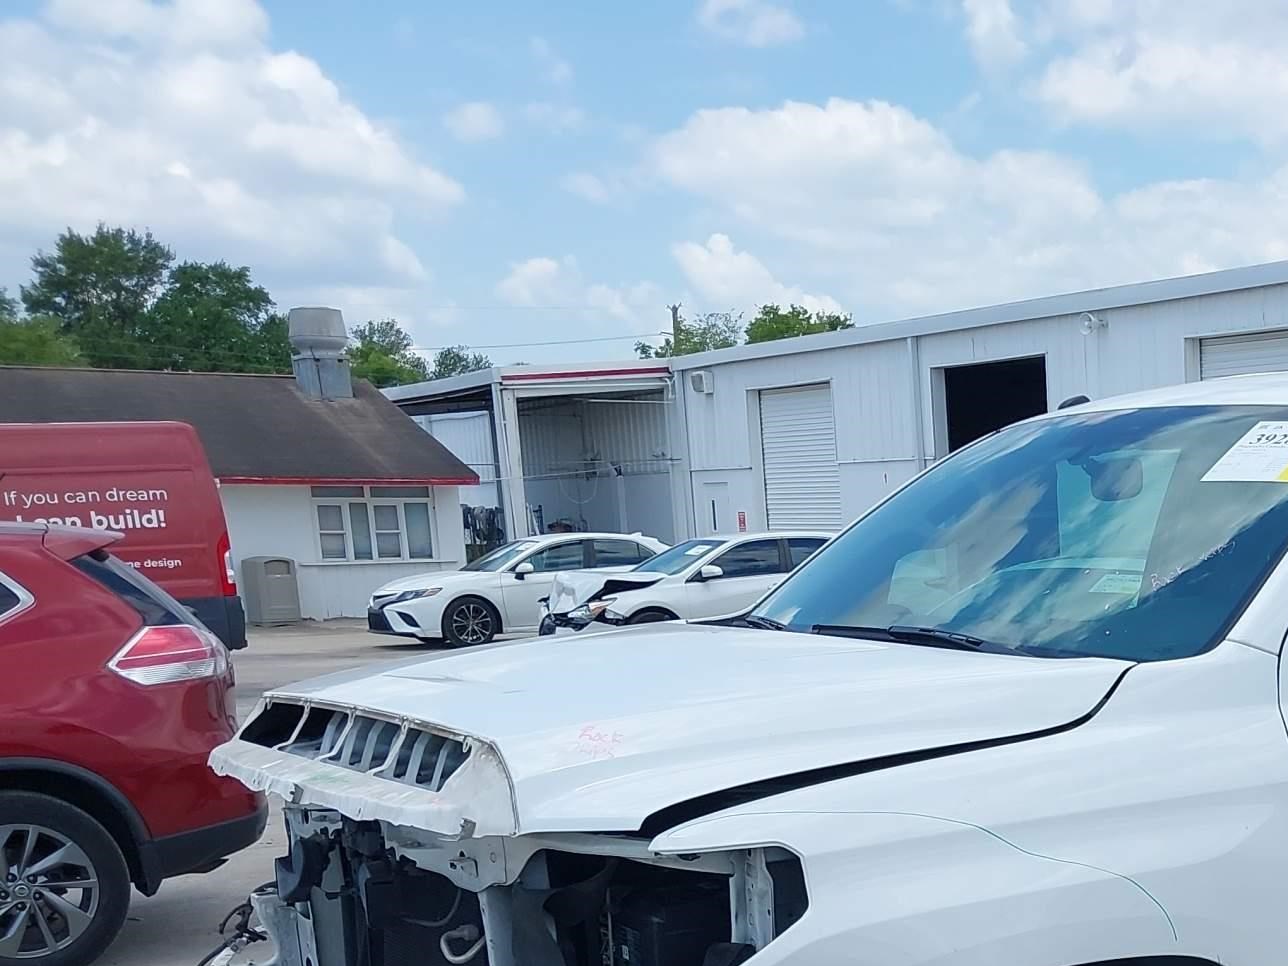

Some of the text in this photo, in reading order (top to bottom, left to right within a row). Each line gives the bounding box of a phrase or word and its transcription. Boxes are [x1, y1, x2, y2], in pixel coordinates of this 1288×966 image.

[4, 487, 168, 509] If you can dream
[89, 508, 167, 531] build!
[143, 557, 182, 569] design
